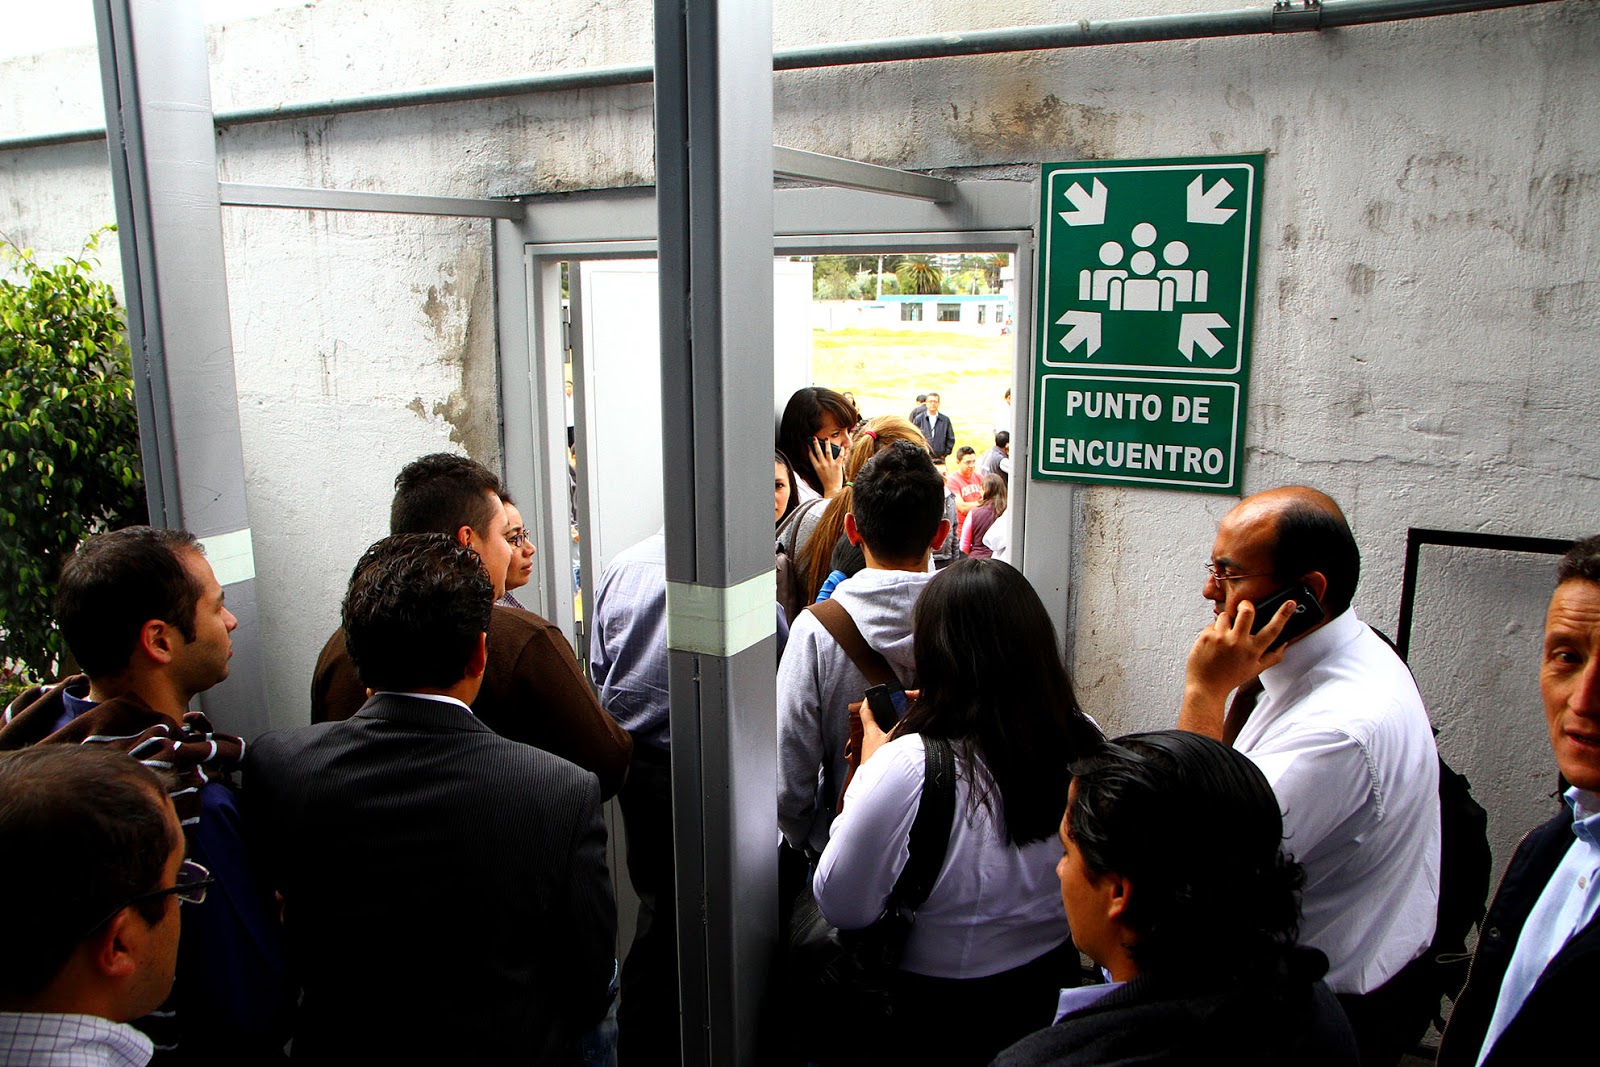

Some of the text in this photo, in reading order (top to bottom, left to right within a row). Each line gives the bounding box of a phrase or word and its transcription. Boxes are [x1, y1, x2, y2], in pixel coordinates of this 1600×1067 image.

[1066, 390, 1211, 424] PUNTO DE
[1049, 437, 1224, 475] ENCUENTRO
